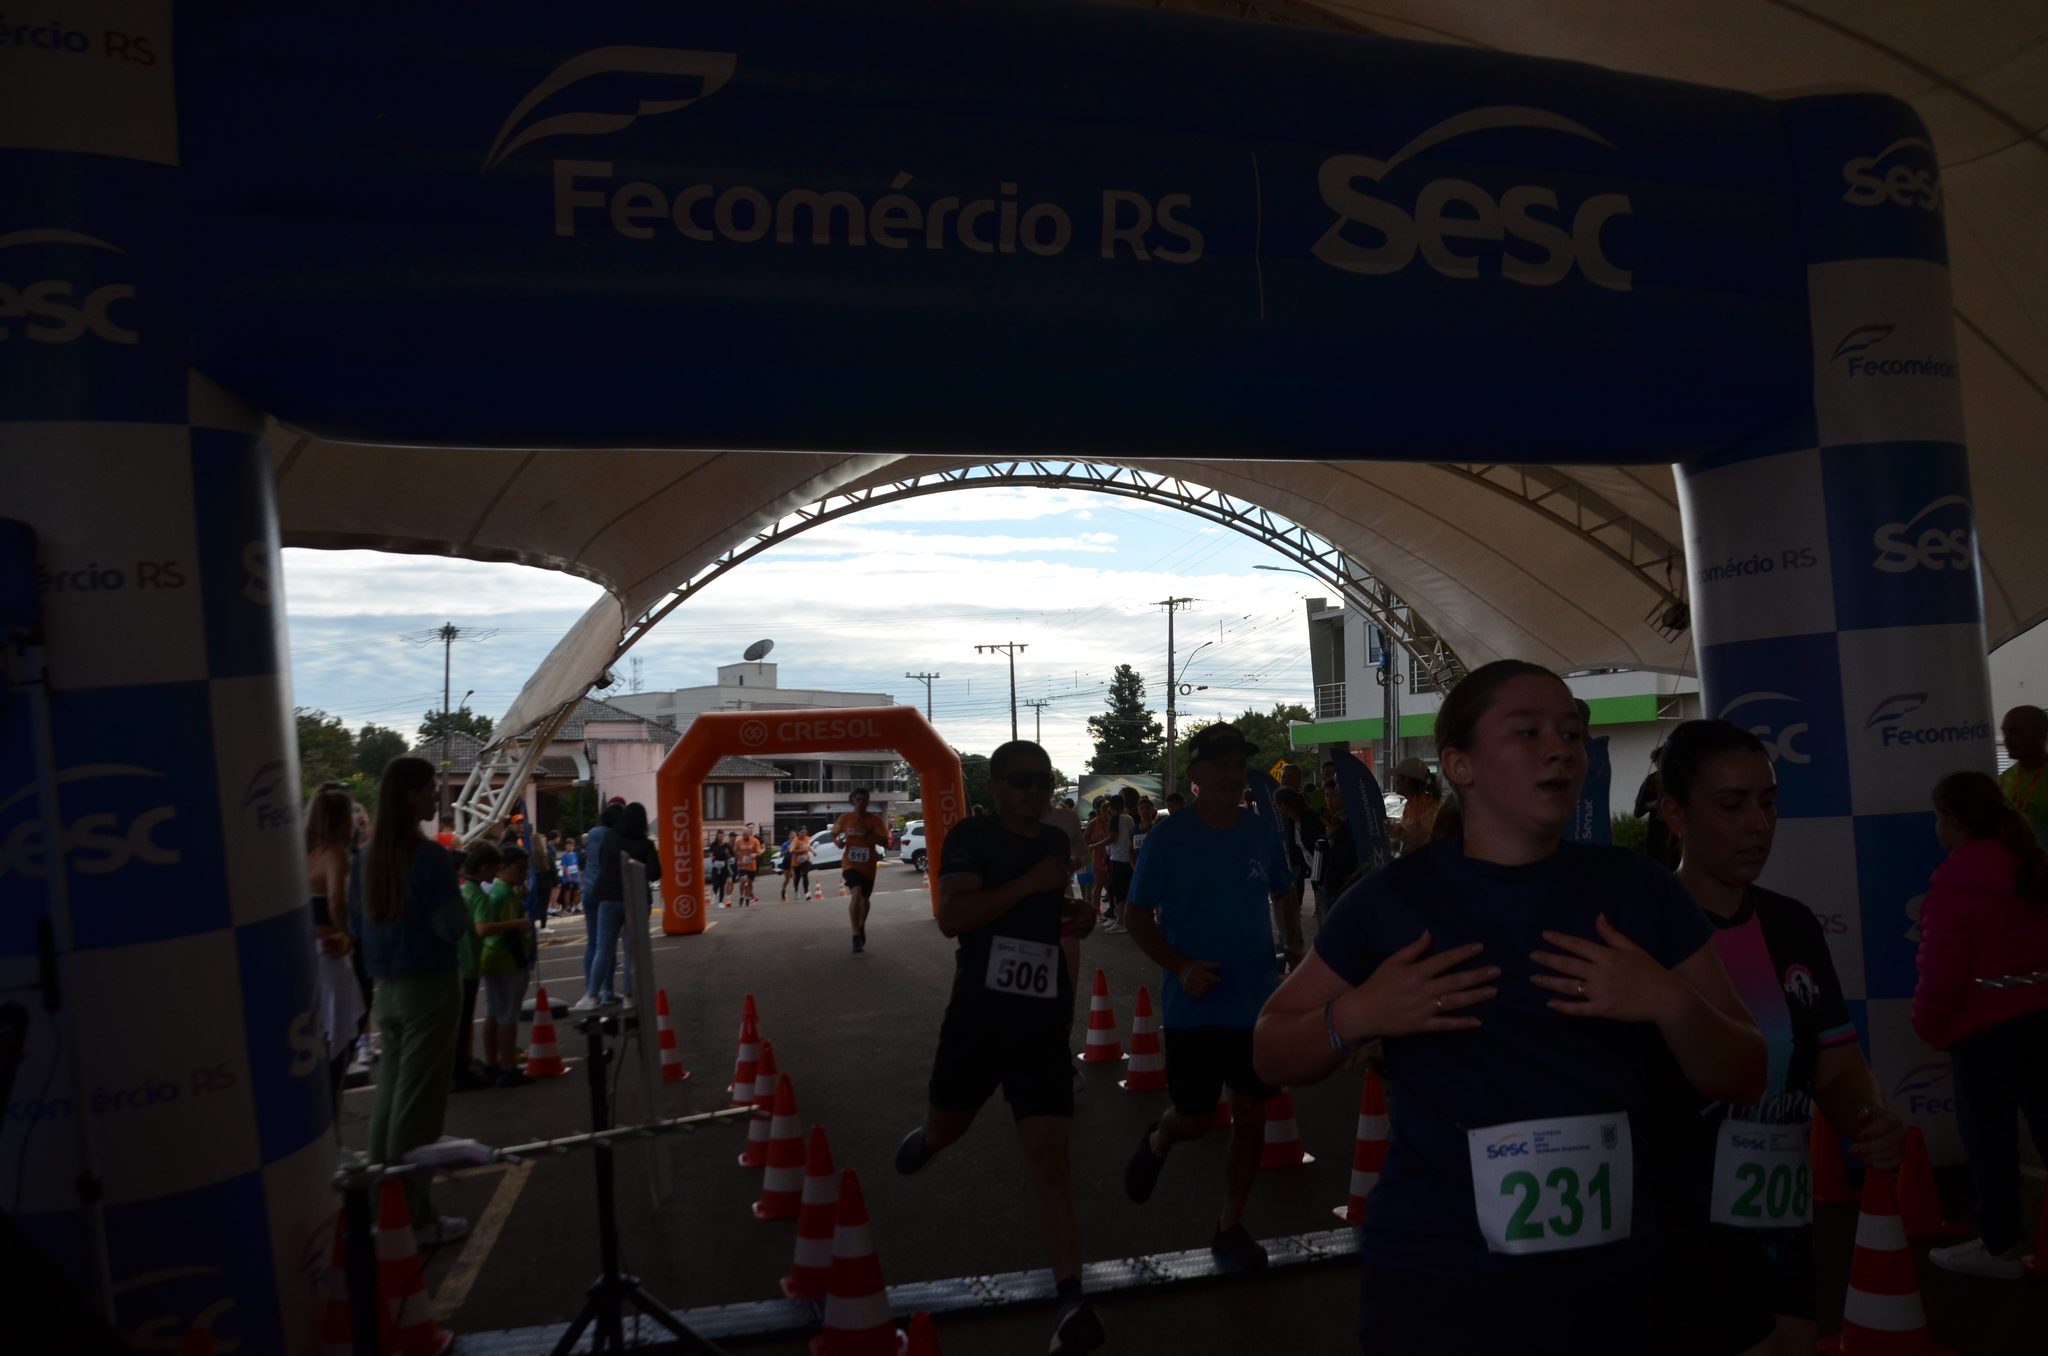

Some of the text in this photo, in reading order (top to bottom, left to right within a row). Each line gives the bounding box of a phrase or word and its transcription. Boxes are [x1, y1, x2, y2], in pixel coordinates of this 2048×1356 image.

[104, 30, 156, 66] RS
[552, 158, 1206, 264] Fecomércio RS
[1309, 152, 1634, 292] Sesc
[136, 560, 186, 590] RS
[1782, 547, 1819, 571] RS
[776, 717, 882, 742] CRESOL
[671, 798, 690, 889] CRESOL
[996, 958, 1049, 994] 506
[191, 1061, 238, 1097] RS
[1500, 1162, 1612, 1242] 231
[1731, 1162, 1808, 1218] 208
